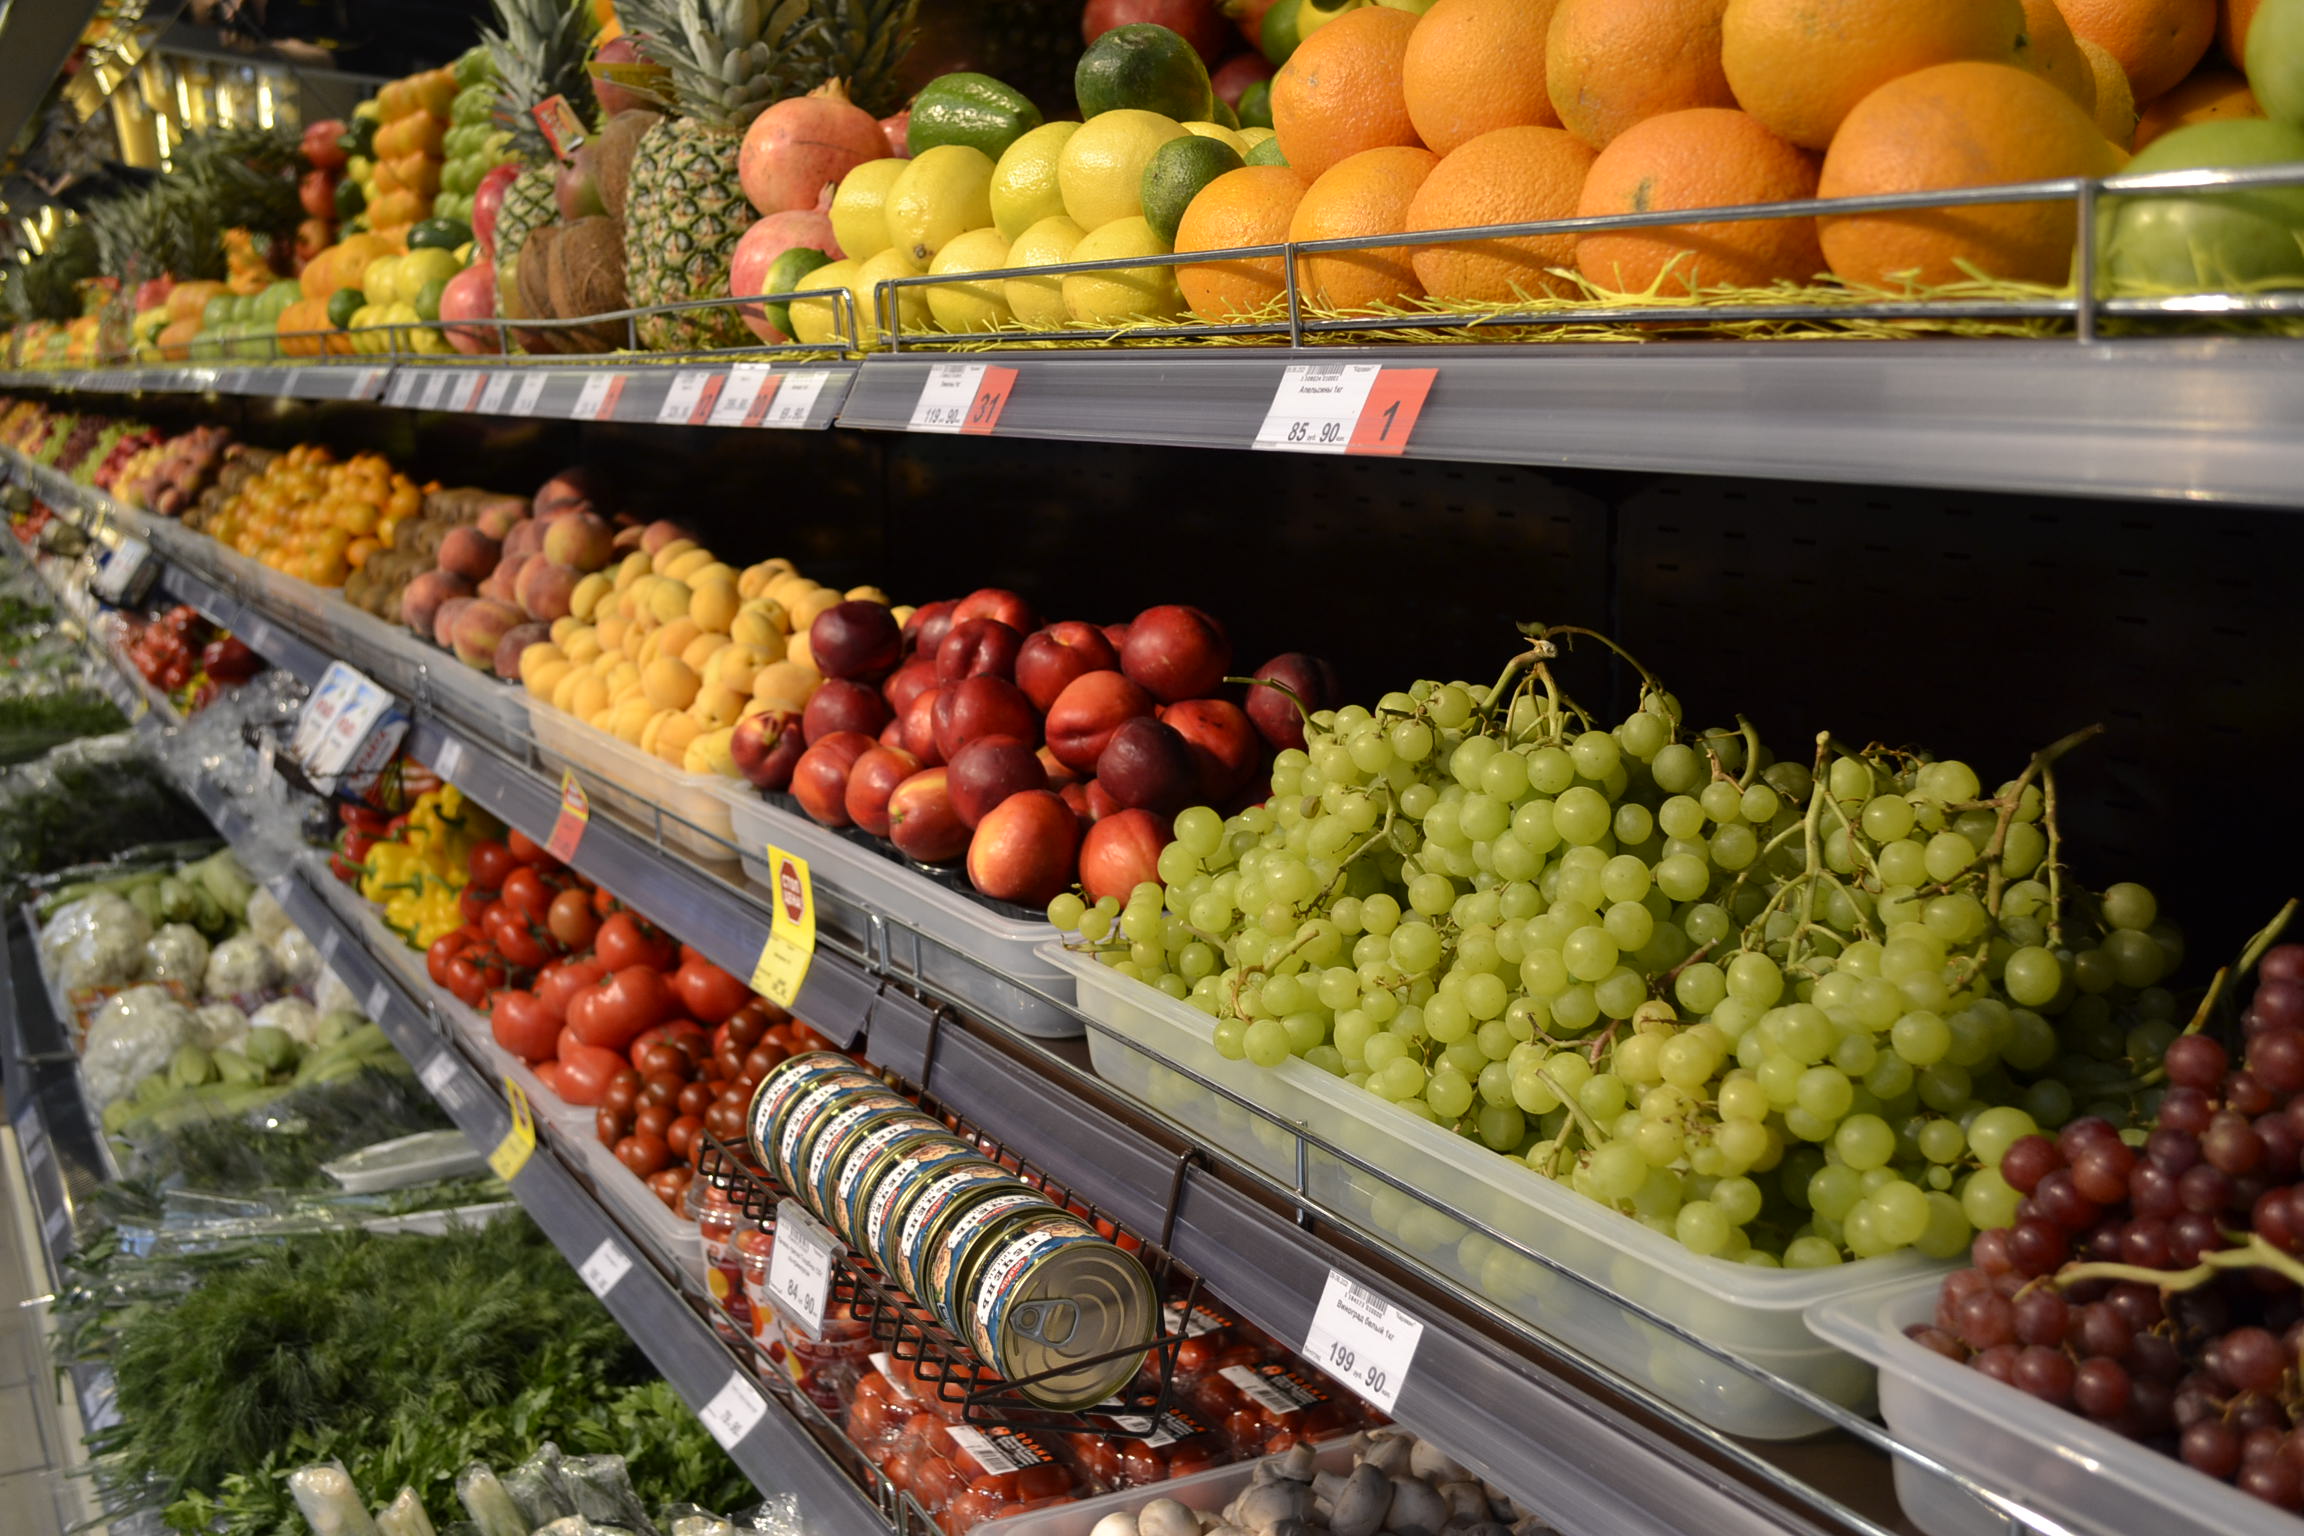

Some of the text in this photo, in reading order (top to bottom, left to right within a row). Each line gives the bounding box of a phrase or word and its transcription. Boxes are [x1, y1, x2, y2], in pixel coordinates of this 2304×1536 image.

[973, 392, 1001, 424] 31
[1299, 385, 1333, 394] Апельсины
[924, 408, 941, 423] 119
[1288, 421, 1309, 442] 85
[1319, 422, 1341, 443] 90
[1379, 400, 1401, 441] 1
[844, 1128, 898, 1185] ПЕЧЕНЬ
[872, 1167, 907, 1239] ПЕЧЕНЬ
[906, 1177, 959, 1242] ПЕЧЕНЬ
[957, 1196, 1030, 1236] ПЕЧЕНЬ
[983, 1238, 1039, 1309] ПЕЧЕНЬ
[787, 1279, 799, 1300] 84
[804, 1293, 815, 1315] 90
[1336, 1299, 1364, 1326] Виноград
[1364, 1315, 1385, 1336] белый
[1329, 1342, 1355, 1372] 199
[1365, 1366, 1386, 1393] 90
